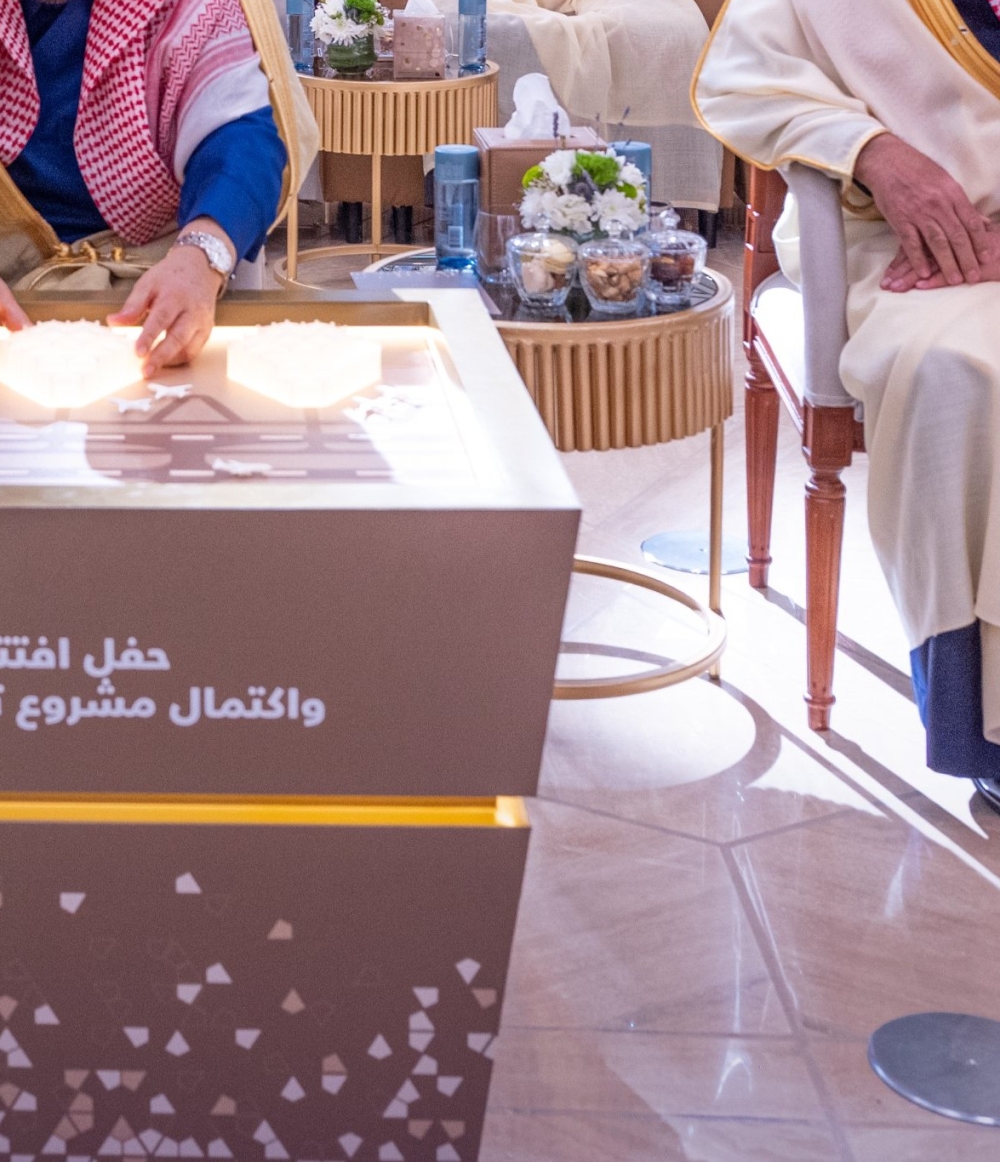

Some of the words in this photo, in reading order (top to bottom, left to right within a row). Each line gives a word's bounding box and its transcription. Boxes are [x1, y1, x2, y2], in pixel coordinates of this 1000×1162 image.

[83, 637, 170, 679] حفل
[15, 678, 156, 731] مشروع
[169, 686, 325, 727] واكتمال
